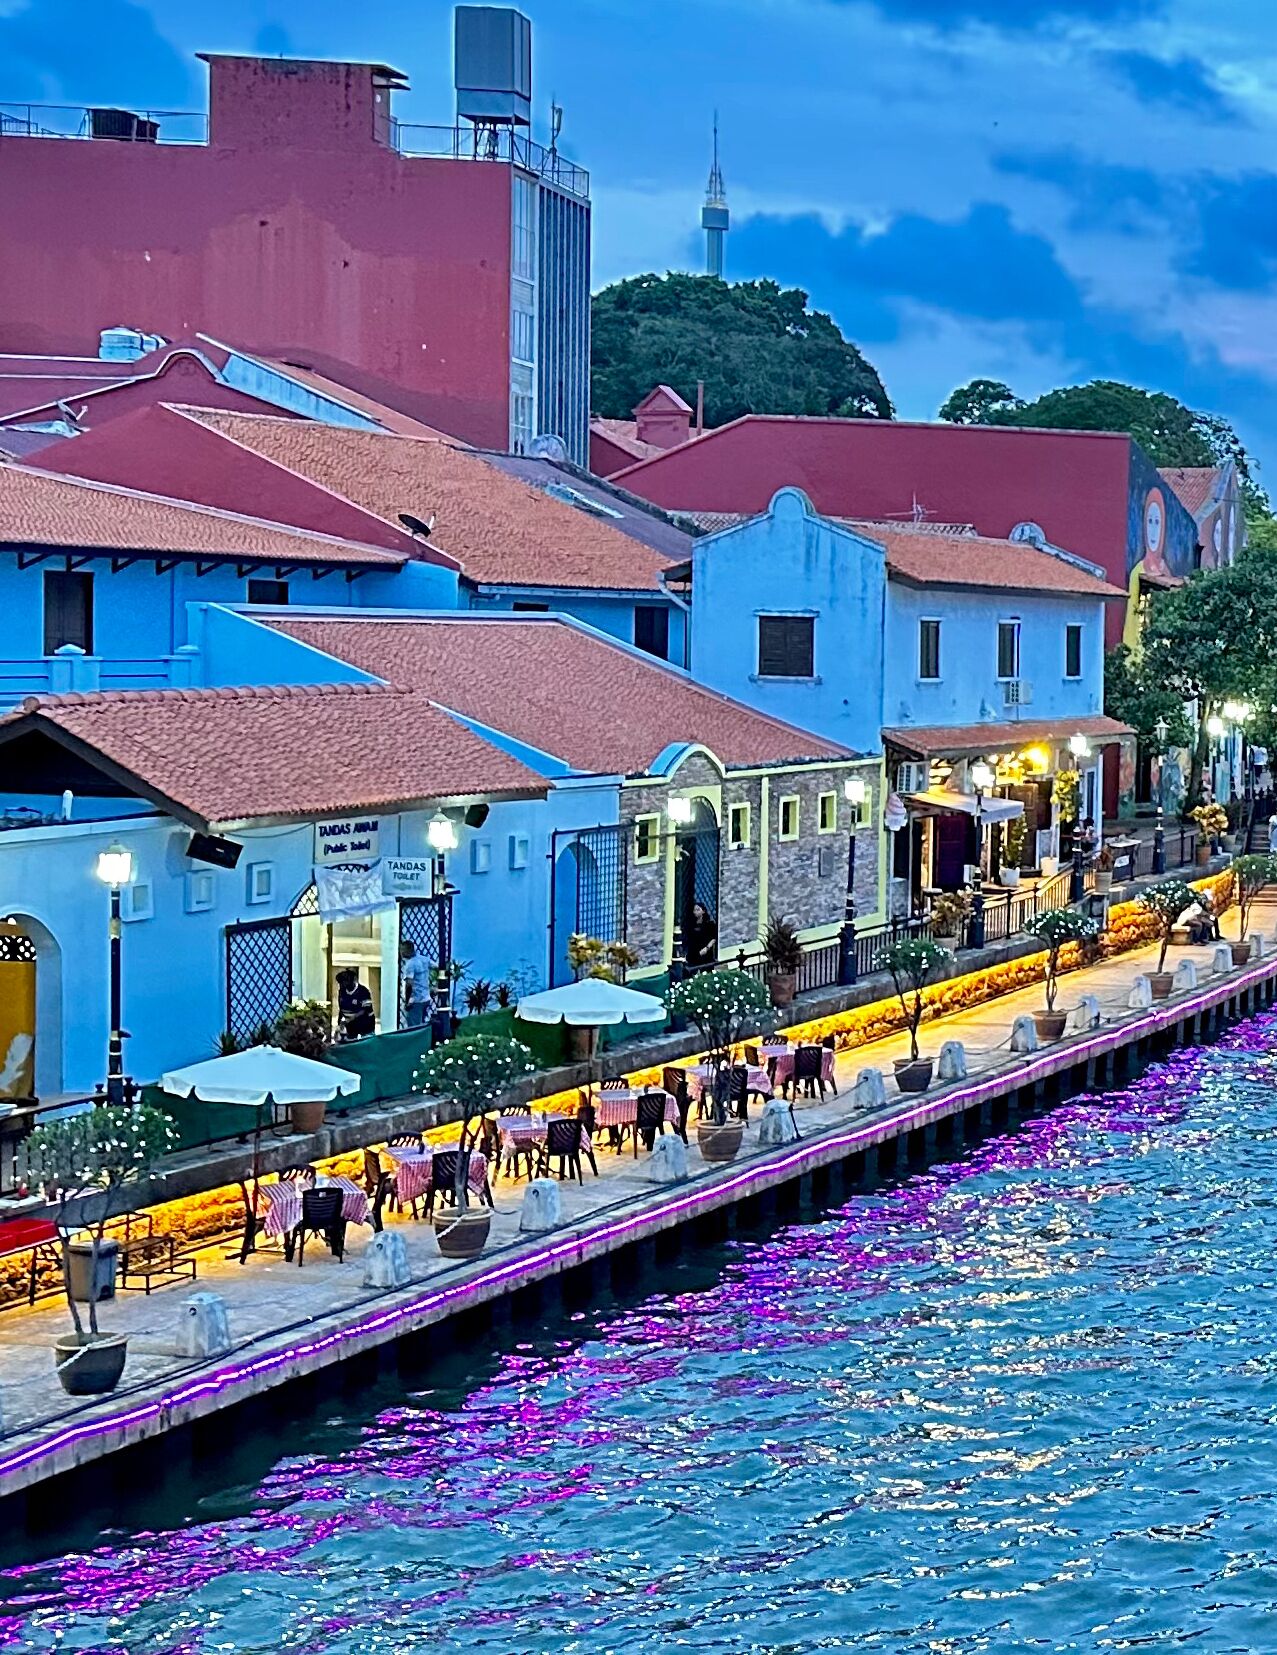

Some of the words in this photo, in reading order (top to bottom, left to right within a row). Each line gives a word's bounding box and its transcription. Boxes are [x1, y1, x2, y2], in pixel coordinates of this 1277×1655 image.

[319, 822, 351, 837] TANDAS
[352, 820, 378, 834] AWAM
[323, 841, 347, 856] (Public
[350, 839, 371, 851] Toilet)
[388, 861, 426, 872] TANDAS
[393, 872, 420, 880] TOILET
